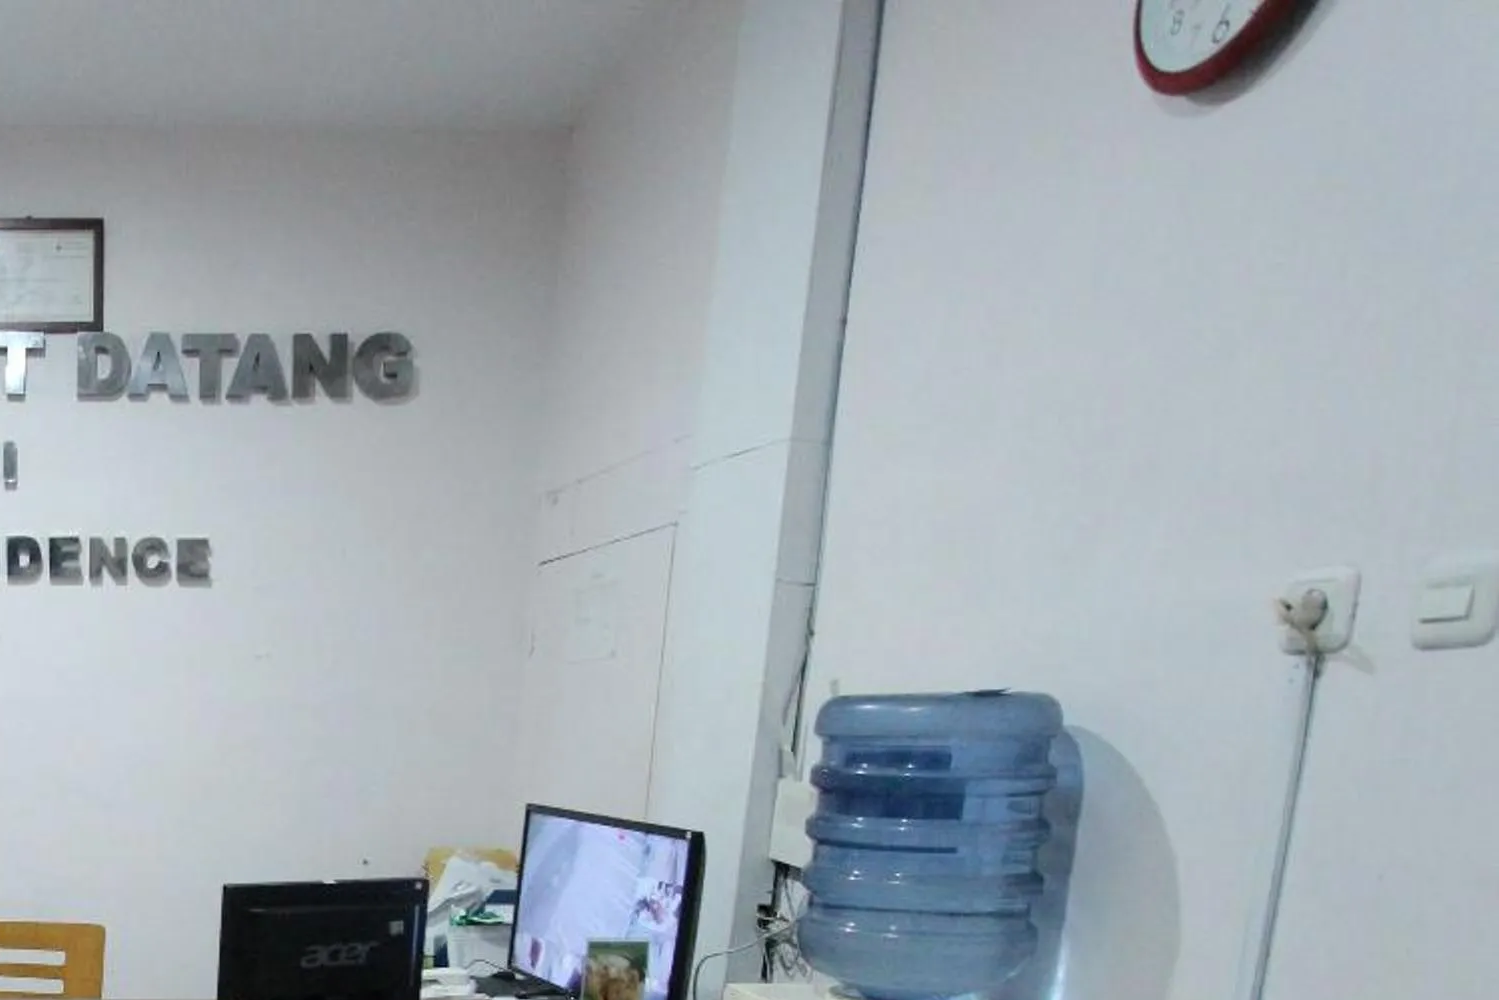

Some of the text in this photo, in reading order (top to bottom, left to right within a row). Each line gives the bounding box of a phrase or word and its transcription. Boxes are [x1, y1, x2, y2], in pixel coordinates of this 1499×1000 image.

[1210, 4, 1231, 44] 6
[76, 331, 418, 405] DATANG
[300, 940, 380, 969] acer
